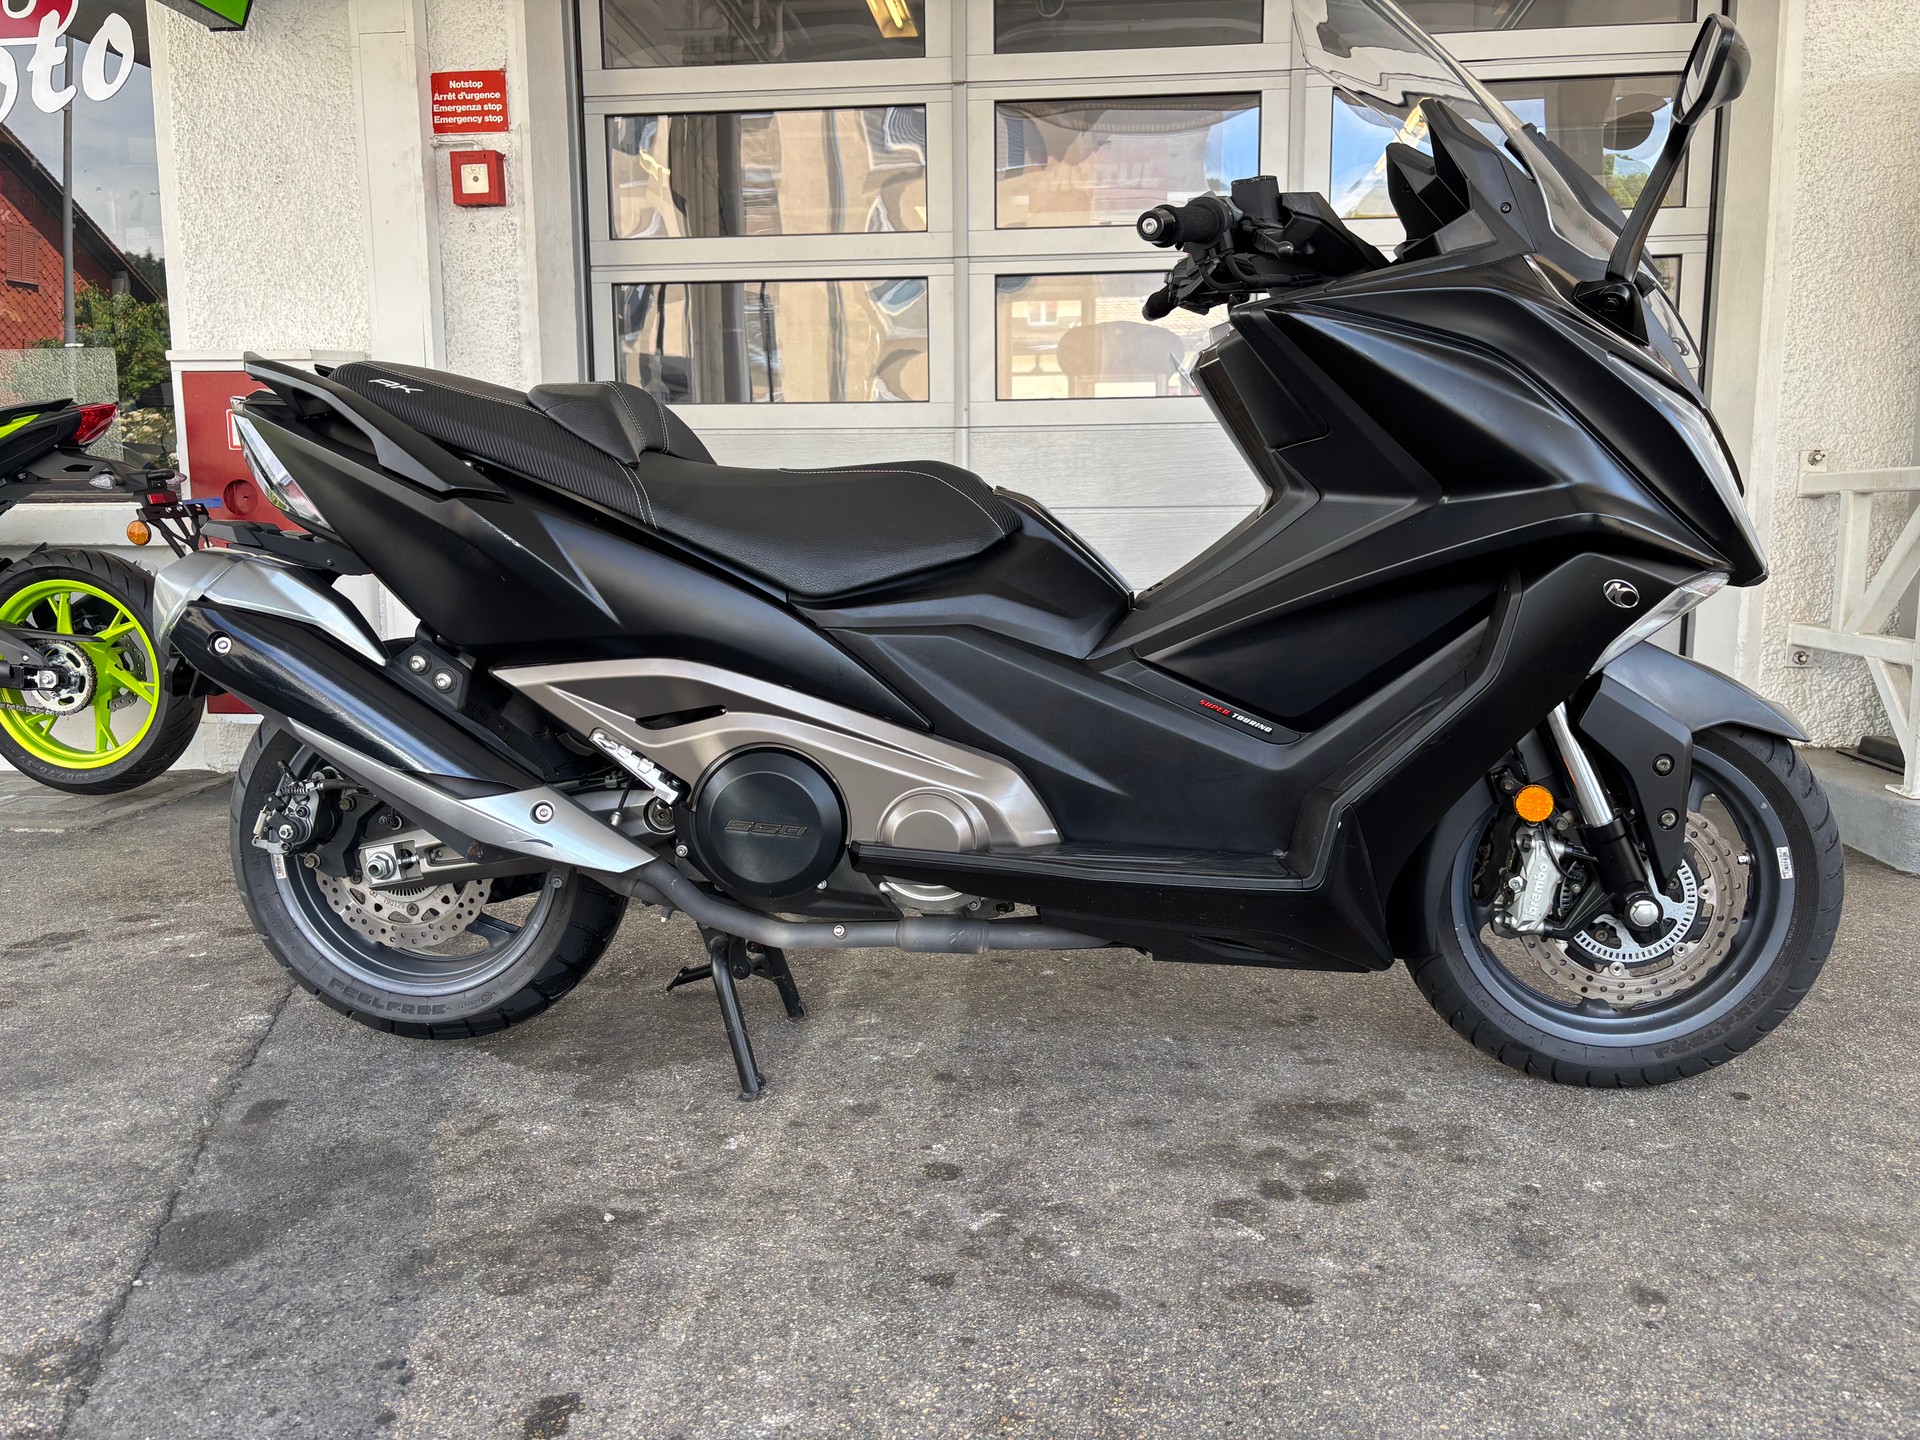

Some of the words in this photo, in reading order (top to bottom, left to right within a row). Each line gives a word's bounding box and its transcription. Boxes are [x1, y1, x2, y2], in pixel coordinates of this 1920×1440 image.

[449, 80, 483, 89] Notstop
[433, 92, 456, 101] Arrêt
[457, 91, 501, 101] d'urgence
[433, 104, 482, 113] Emergenza
[483, 102, 503, 112] stop
[434, 115, 483, 125] Emergency
[484, 114, 504, 123] stop
[368, 378, 424, 394] AK
[1199, 699, 1231, 715] SUPER
[1231, 712, 1273, 733] TOURING
[723, 819, 808, 838] 550
[1523, 862, 1548, 916] brembo
[327, 976, 446, 1016] FEELFREE
